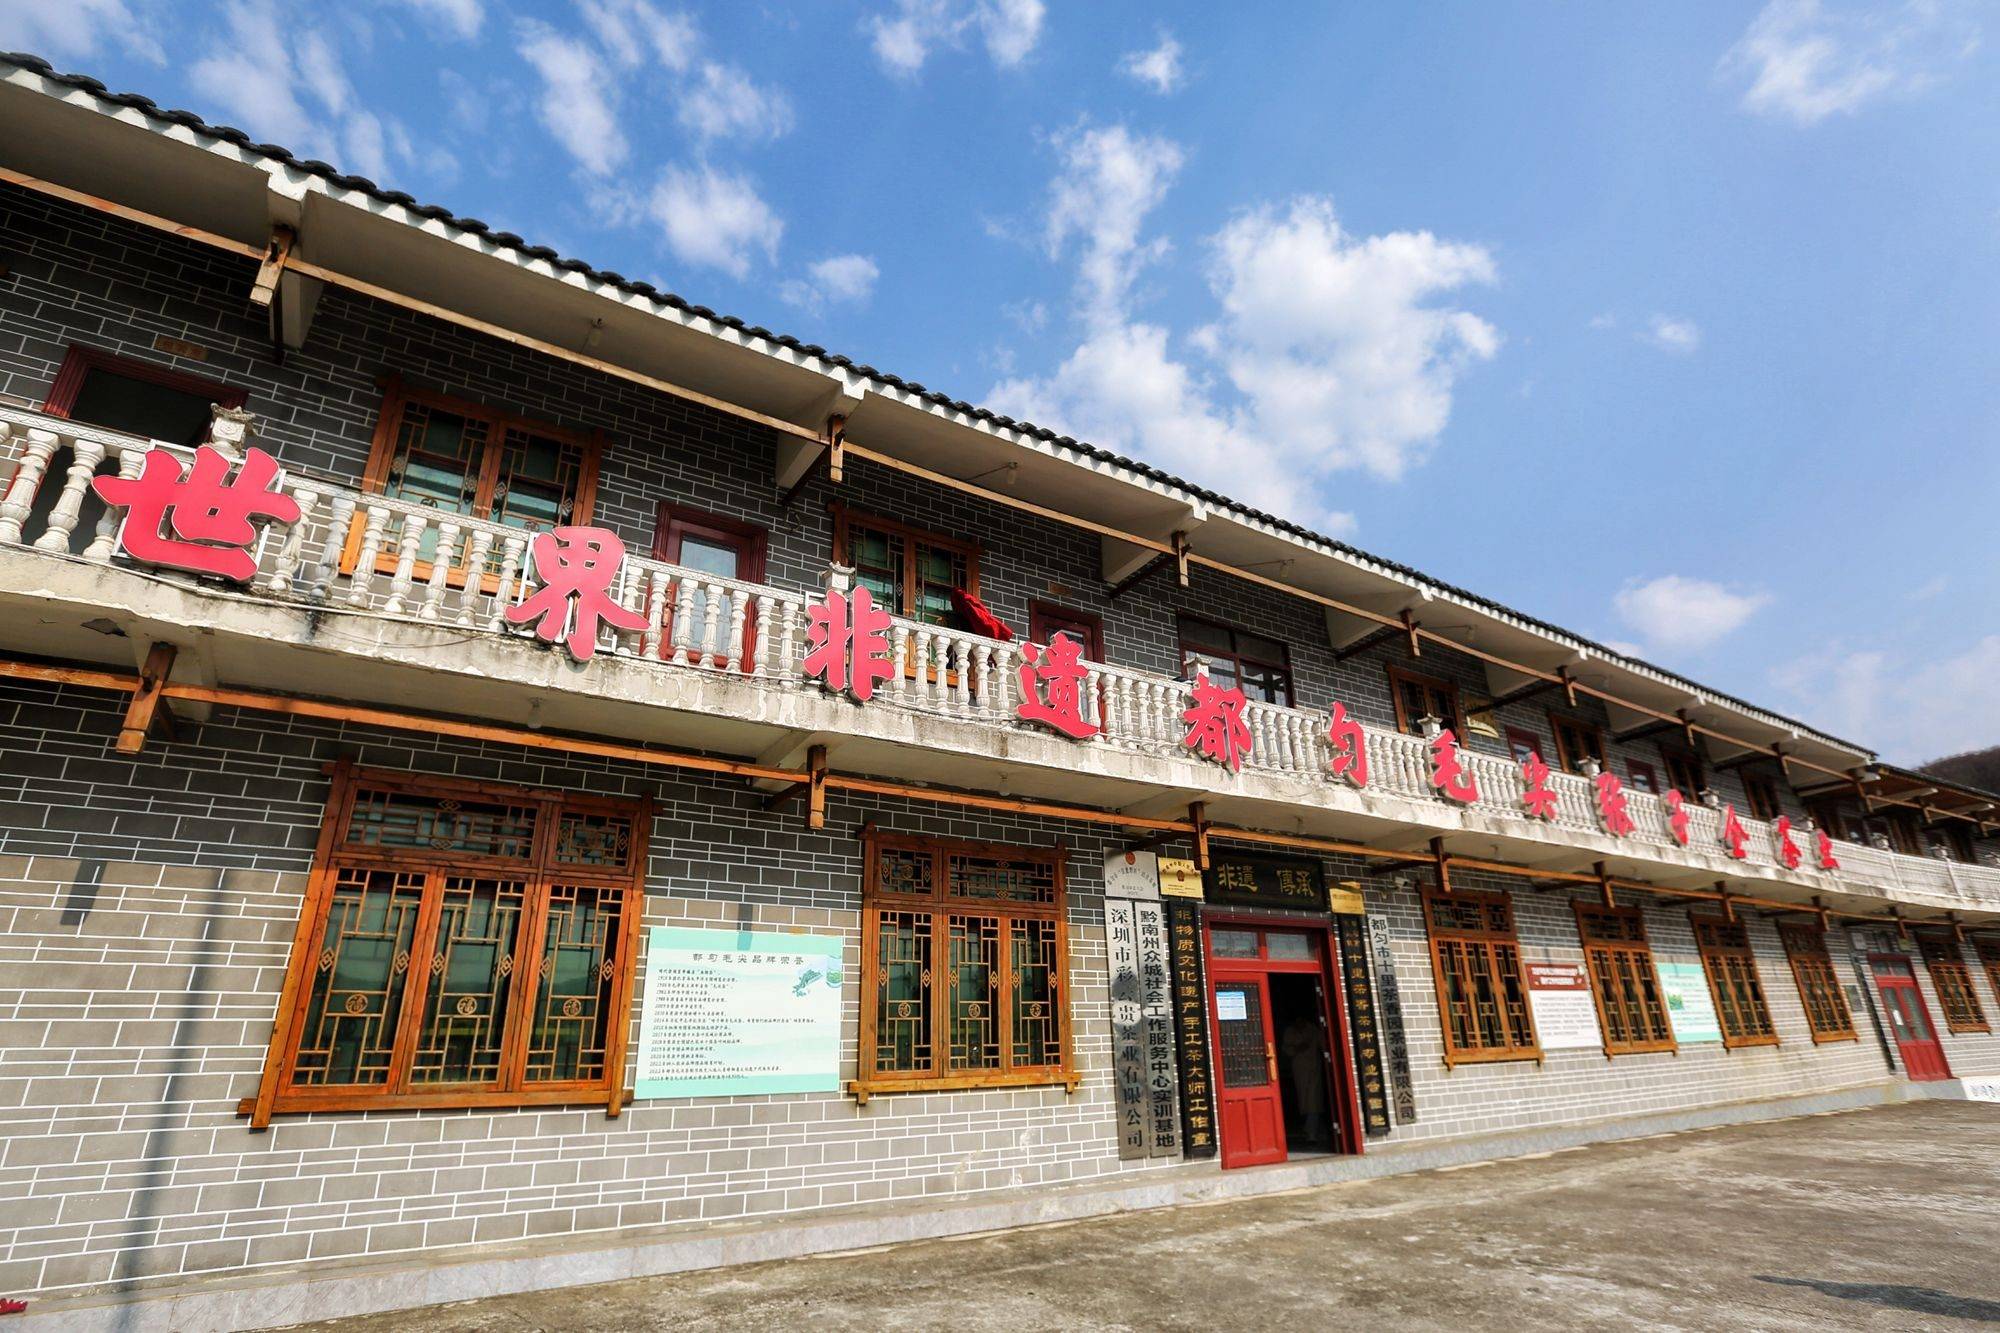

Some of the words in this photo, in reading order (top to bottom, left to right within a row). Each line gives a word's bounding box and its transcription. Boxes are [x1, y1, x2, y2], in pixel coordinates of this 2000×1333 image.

[692, 952, 805, 966] 都匀毛尖品牌荣誉
[1140, 909, 1177, 1148] 黔南州众城社会工作服务中心实训基地
[1343, 919, 1387, 1127] 十里茶香茶叶专业合作社
